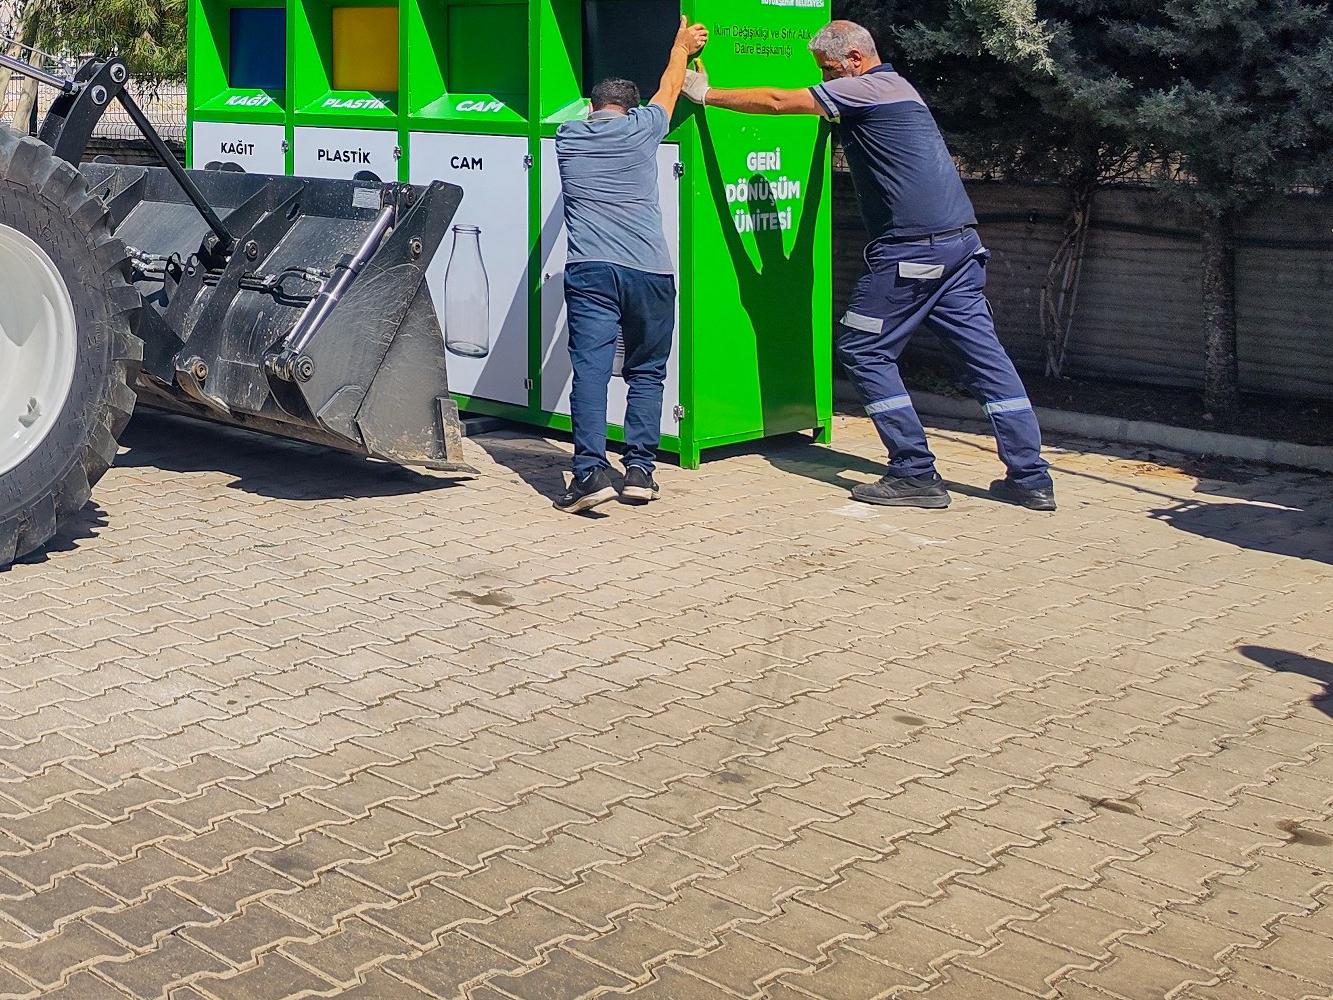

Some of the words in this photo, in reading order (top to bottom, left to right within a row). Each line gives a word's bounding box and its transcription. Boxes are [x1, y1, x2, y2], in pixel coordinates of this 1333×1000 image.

[771, 30, 780, 38] ve
[734, 42, 755, 55] Daire
[225, 94, 276, 106] KAĞIT
[321, 98, 390, 109] PLASTİK
[455, 100, 507, 113] CAM
[220, 139, 255, 156] KAĞIT
[317, 148, 371, 164] PLASTİK
[450, 155, 483, 170] CAM
[746, 147, 781, 171] GERİ
[725, 176, 801, 206] DÖNÜŞÜM
[734, 206, 792, 233] ÜNİTESİ
